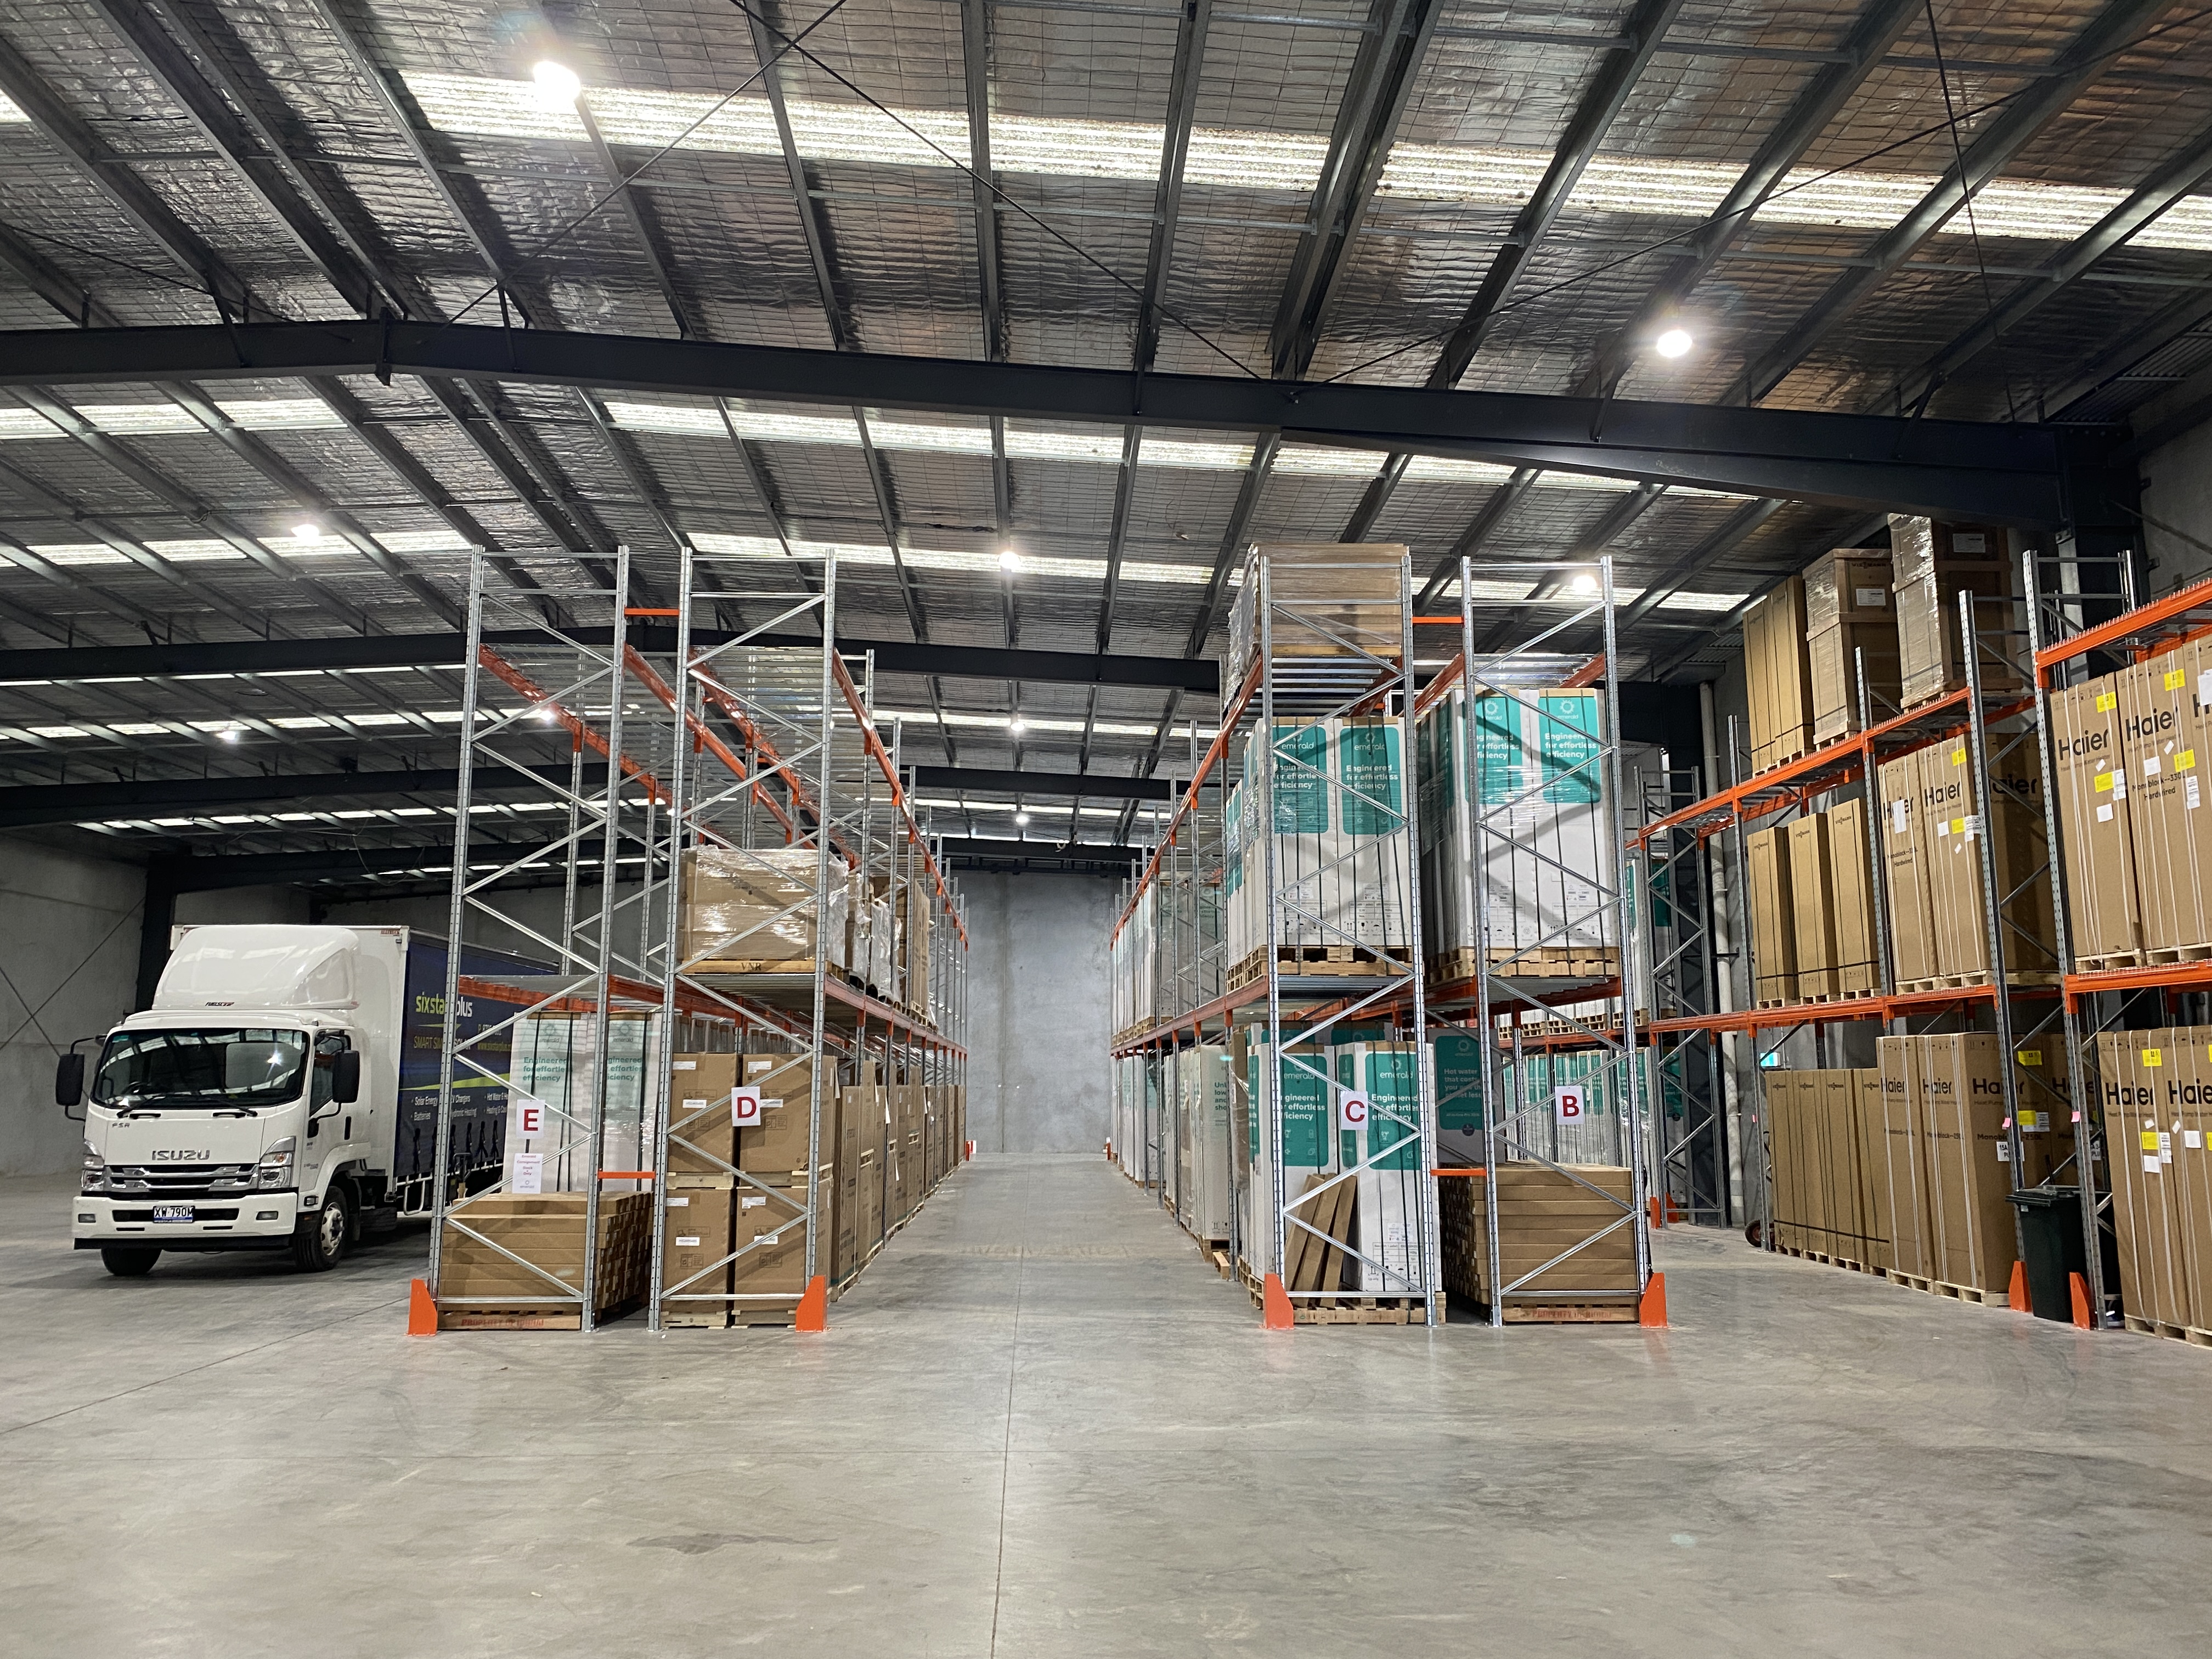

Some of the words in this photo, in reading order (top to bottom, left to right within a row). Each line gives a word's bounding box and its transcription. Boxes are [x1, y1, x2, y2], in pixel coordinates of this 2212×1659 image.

[2058, 729, 2109, 760] Haier
[1925, 781, 1960, 807] Haier
[1883, 797, 1914, 820] Her
[1973, 1078, 2024, 1094] Har
[2106, 1081, 2154, 1105] Haier
[2168, 1078, 2212, 1104] Haie
[415, 1097, 425, 1106] Solar
[425, 1096, 438, 1107] Energy
[456, 1094, 470, 1104] Chargers
[737, 1097, 757, 1119] D
[1562, 1095, 1580, 1117] B
[414, 1111, 431, 1121] Batteries
[524, 1109, 539, 1131] E
[1345, 1100, 1365, 1122] C
[152, 1150, 210, 1160] ISUZU
